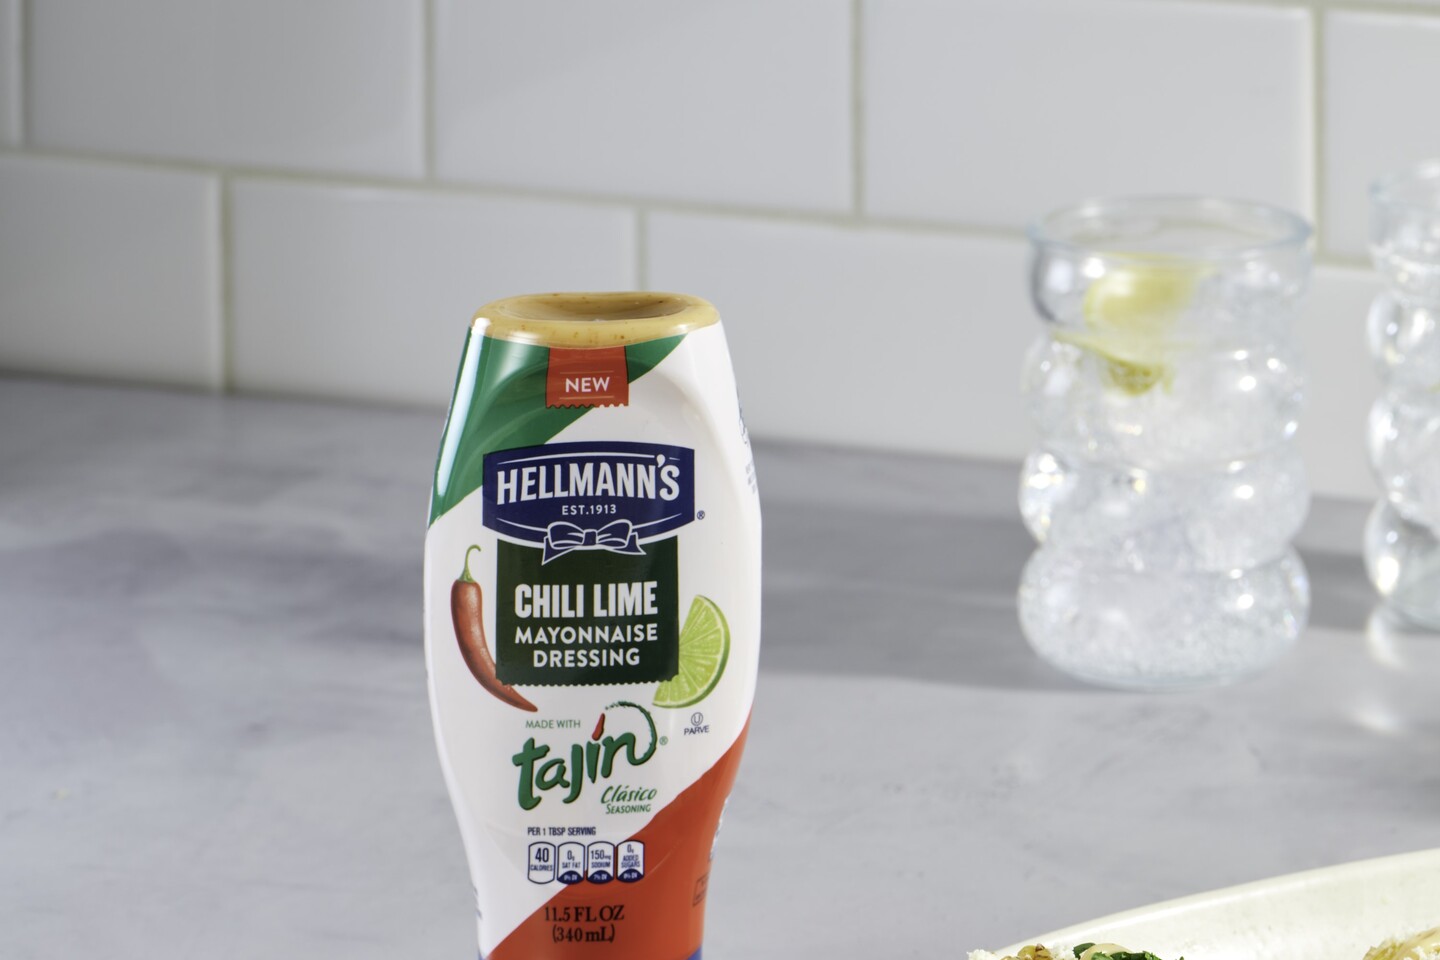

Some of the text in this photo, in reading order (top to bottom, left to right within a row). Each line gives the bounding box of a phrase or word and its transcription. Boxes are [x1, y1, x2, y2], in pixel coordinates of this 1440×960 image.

[565, 376, 610, 393] NEW
[496, 454, 681, 505] HELLMANN'S
[514, 580, 658, 618] CHILI LIME
[514, 623, 658, 644] MAYONNAISE
[533, 648, 640, 668] DRESSING
[525, 719, 581, 729] MADE WITH
[683, 725, 710, 736] PARVE
[601, 785, 657, 804] Clásico
[527, 827, 541, 836] PER
[549, 827, 566, 836] TBSP
[567, 827, 596, 836] SERVING
[535, 847, 549, 863] 40
[545, 904, 625, 922] 11.5 FL OZ
[552, 923, 615, 943] (340 mL)
